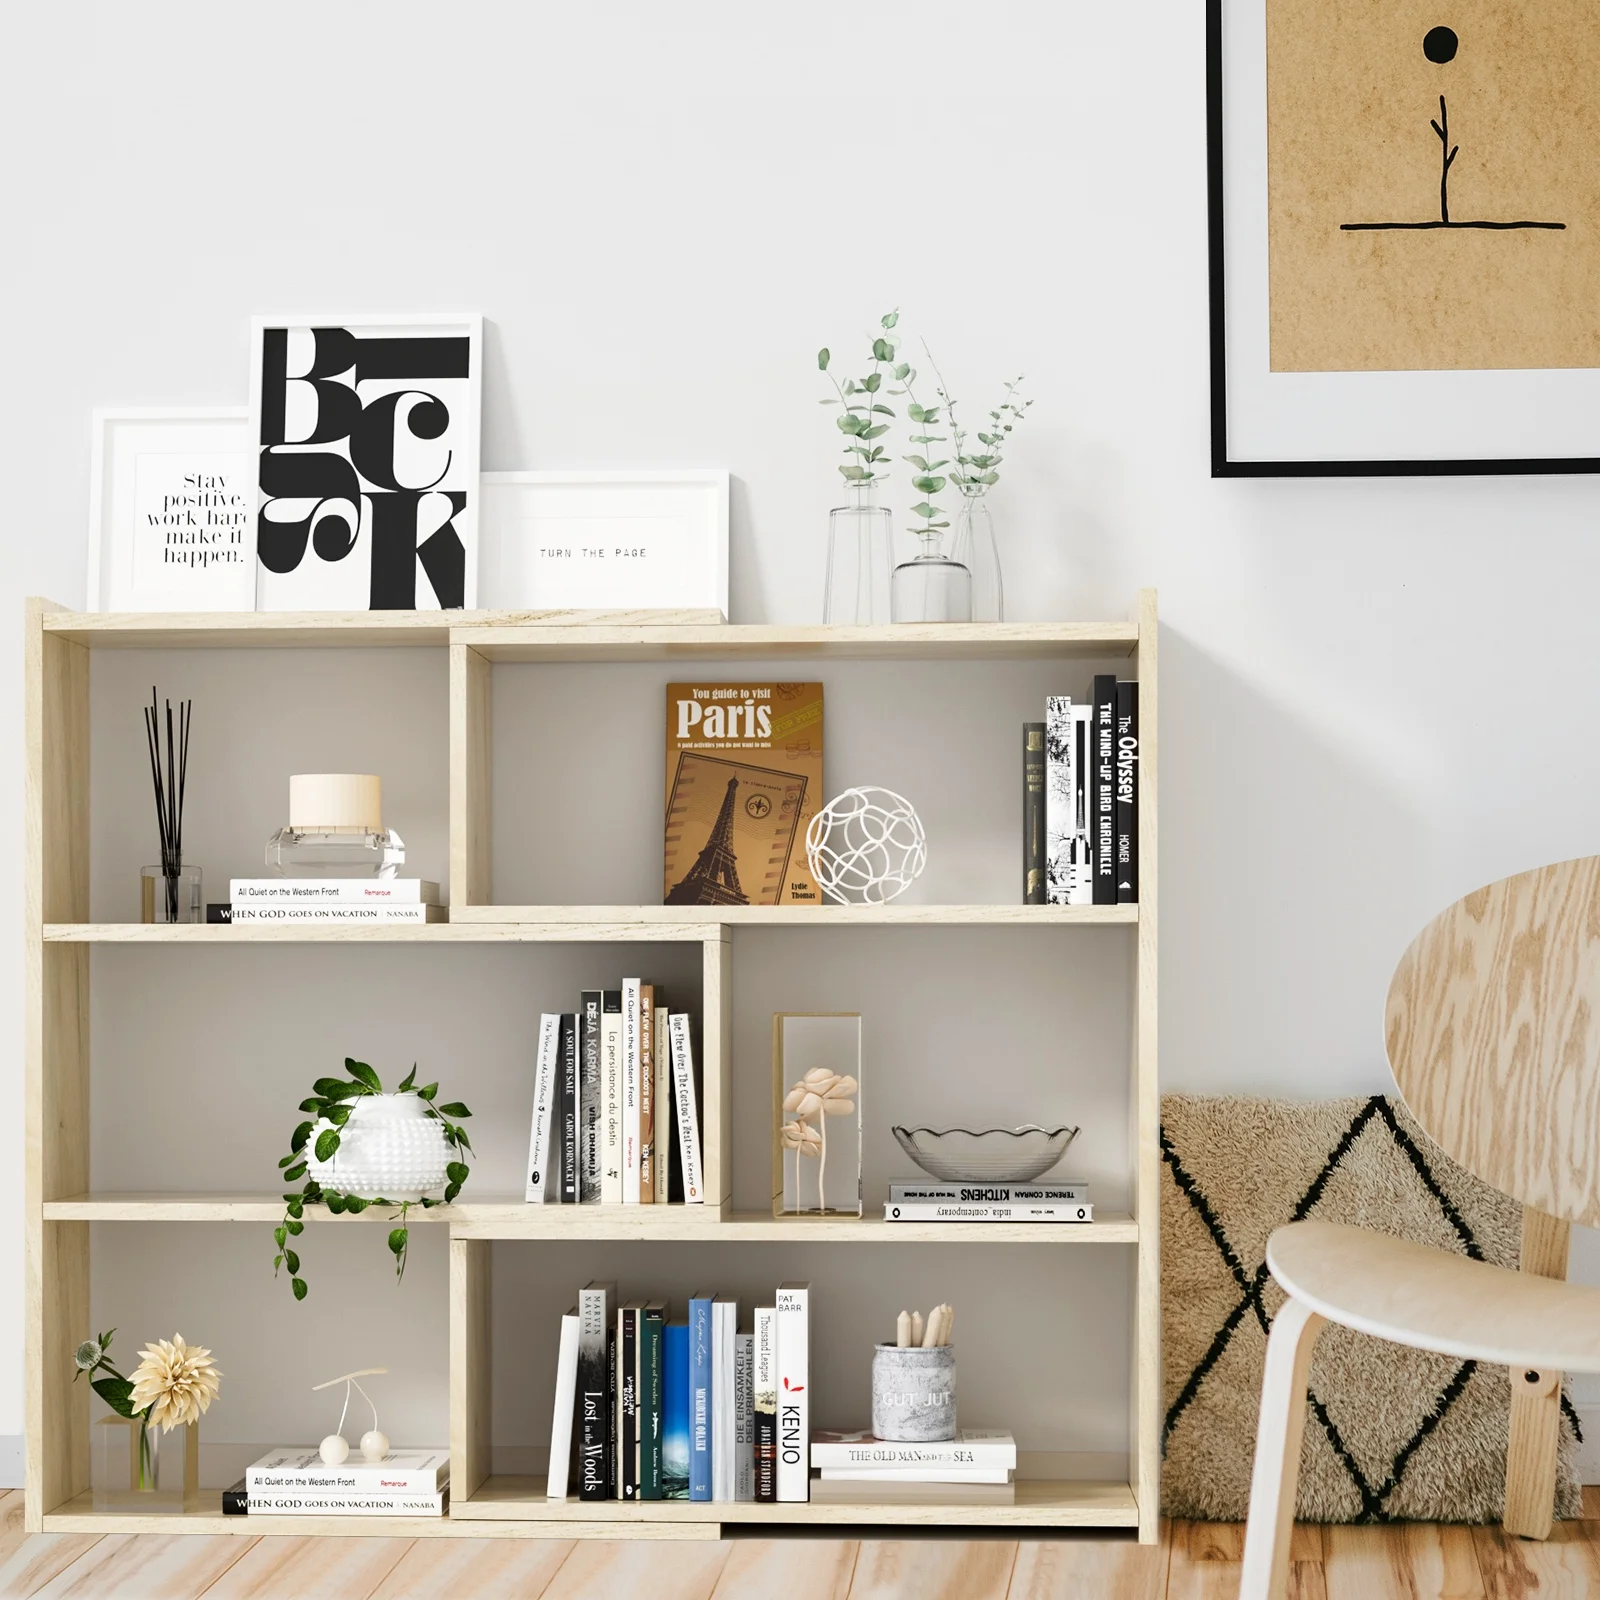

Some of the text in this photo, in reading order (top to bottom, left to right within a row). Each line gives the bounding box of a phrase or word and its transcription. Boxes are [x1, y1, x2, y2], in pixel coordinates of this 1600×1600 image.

[183, 472, 229, 489] Stay
[148, 510, 197, 526] work
[165, 526, 244, 544] make it
[540, 548, 647, 558] TURN THE PAGE
[692, 688, 771, 700] You guide to visit
[676, 699, 772, 739] Paris
[1100, 703, 1111, 875] THE WIND-UP BIRD CHRONICLE
[1117, 716, 1138, 863] The Odyssey HOMER
[238, 888, 247, 896] All
[248, 887, 268, 896] Quiet
[279, 888, 290, 896] the
[292, 888, 320, 896] Western
[321, 888, 340, 896] Front
[364, 889, 391, 897] Remarque
[791, 882, 808, 891] Lydie
[791, 891, 816, 900] Thomas
[220, 909, 256, 919] WHEN
[259, 909, 286, 919] GOD
[288, 910, 313, 918] GOES
[314, 910, 329, 918] ON
[331, 910, 377, 918] VACATION
[628, 1024, 633, 1034] on
[673, 1017, 684, 1031] One
[543, 1034, 551, 1053] Wind
[566, 1036, 574, 1057] SOUL
[675, 1033, 684, 1051] Flew
[566, 1058, 574, 1073] FOR
[676, 1053, 687, 1071] Over
[539, 1075, 549, 1103] Willows
[566, 1075, 574, 1095] SALE
[586, 1002, 599, 1176] DÉJÀ KARMA VISH DHAMIJA
[606, 1031, 617, 1146] La persistance du destin
[678, 1073, 688, 1089] The
[679, 1089, 691, 1124] Cuckoo's
[566, 1114, 574, 1140] CAROL
[682, 1126, 692, 1143] Nest
[566, 1142, 574, 1182] KORNACKI
[687, 1162, 696, 1186] Kesey
[960, 1189, 1010, 1201] KITCHENS
[937, 1207, 1012, 1218] india_contemporary
[778, 1295, 794, 1303] PAT
[778, 1304, 802, 1312] BARR
[584, 1295, 592, 1335] NAVINA
[593, 1295, 601, 1335] MARVIN
[758, 1316, 770, 1382] Thousand Leagues
[652, 1369, 658, 1377] of
[737, 1348, 745, 1420] EINSAMKEIT
[745, 1339, 753, 1443] DER PRIMZAHLEN
[882, 1392, 951, 1406] GUT JUT
[584, 1391, 604, 1491] Lost in the Woods
[782, 1406, 801, 1464] KENJO
[760, 1425, 772, 1496] JONATHAN STANDFORD
[849, 1450, 871, 1461] THE
[873, 1450, 896, 1461] OLD
[898, 1450, 922, 1461] MAN
[953, 1450, 974, 1462] SEA
[254, 1477, 263, 1486] All
[264, 1477, 283, 1486] Quiet
[295, 1477, 307, 1486] the
[308, 1477, 336, 1486] Western
[337, 1477, 355, 1486] Front
[380, 1480, 407, 1488] Remarque
[236, 1498, 273, 1508] WHEN
[275, 1499, 302, 1508] GOD
[304, 1500, 328, 1508] GOES
[330, 1500, 345, 1508] ON
[347, 1501, 394, 1509] VACATION
